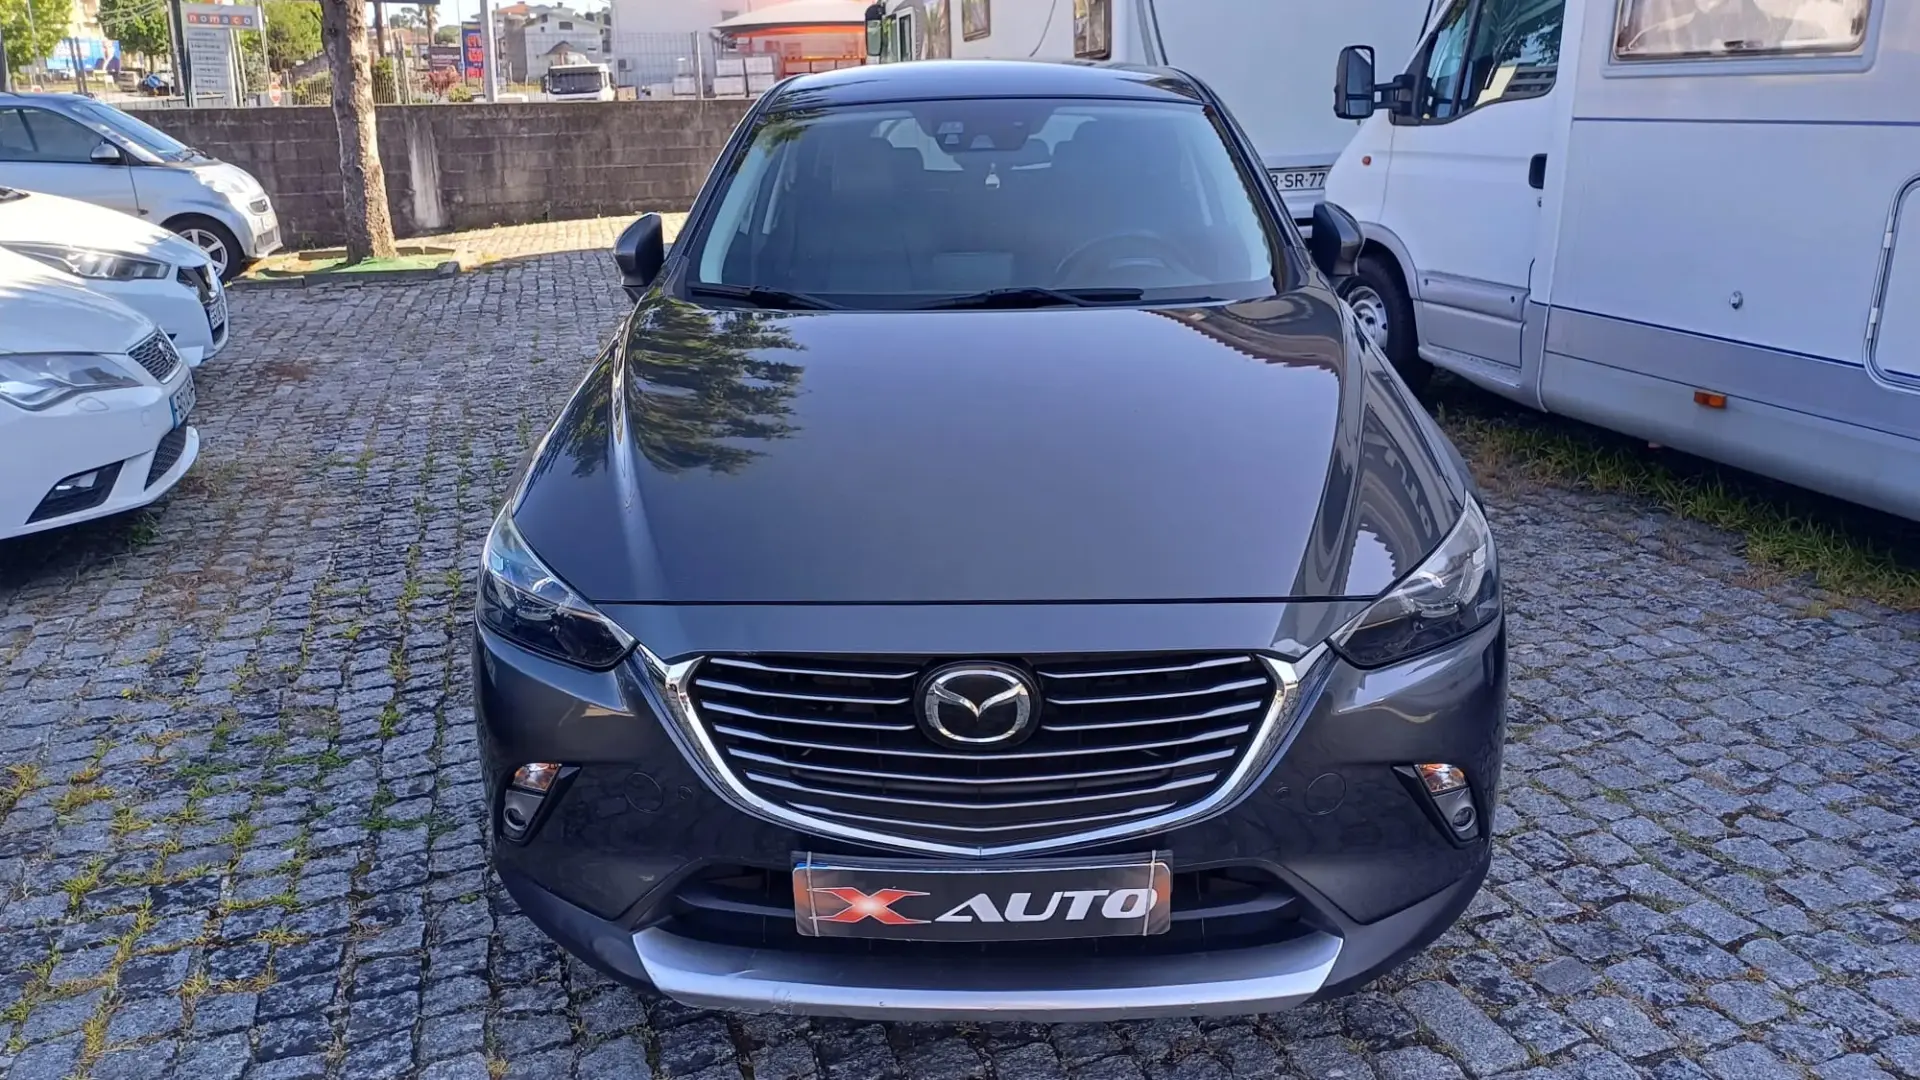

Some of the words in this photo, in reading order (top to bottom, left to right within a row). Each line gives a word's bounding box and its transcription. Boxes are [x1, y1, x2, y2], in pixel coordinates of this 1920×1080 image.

[188, 13, 252, 25] nomaco
[806, 886, 931, 924] X
[934, 888, 1157, 922] AUTO
